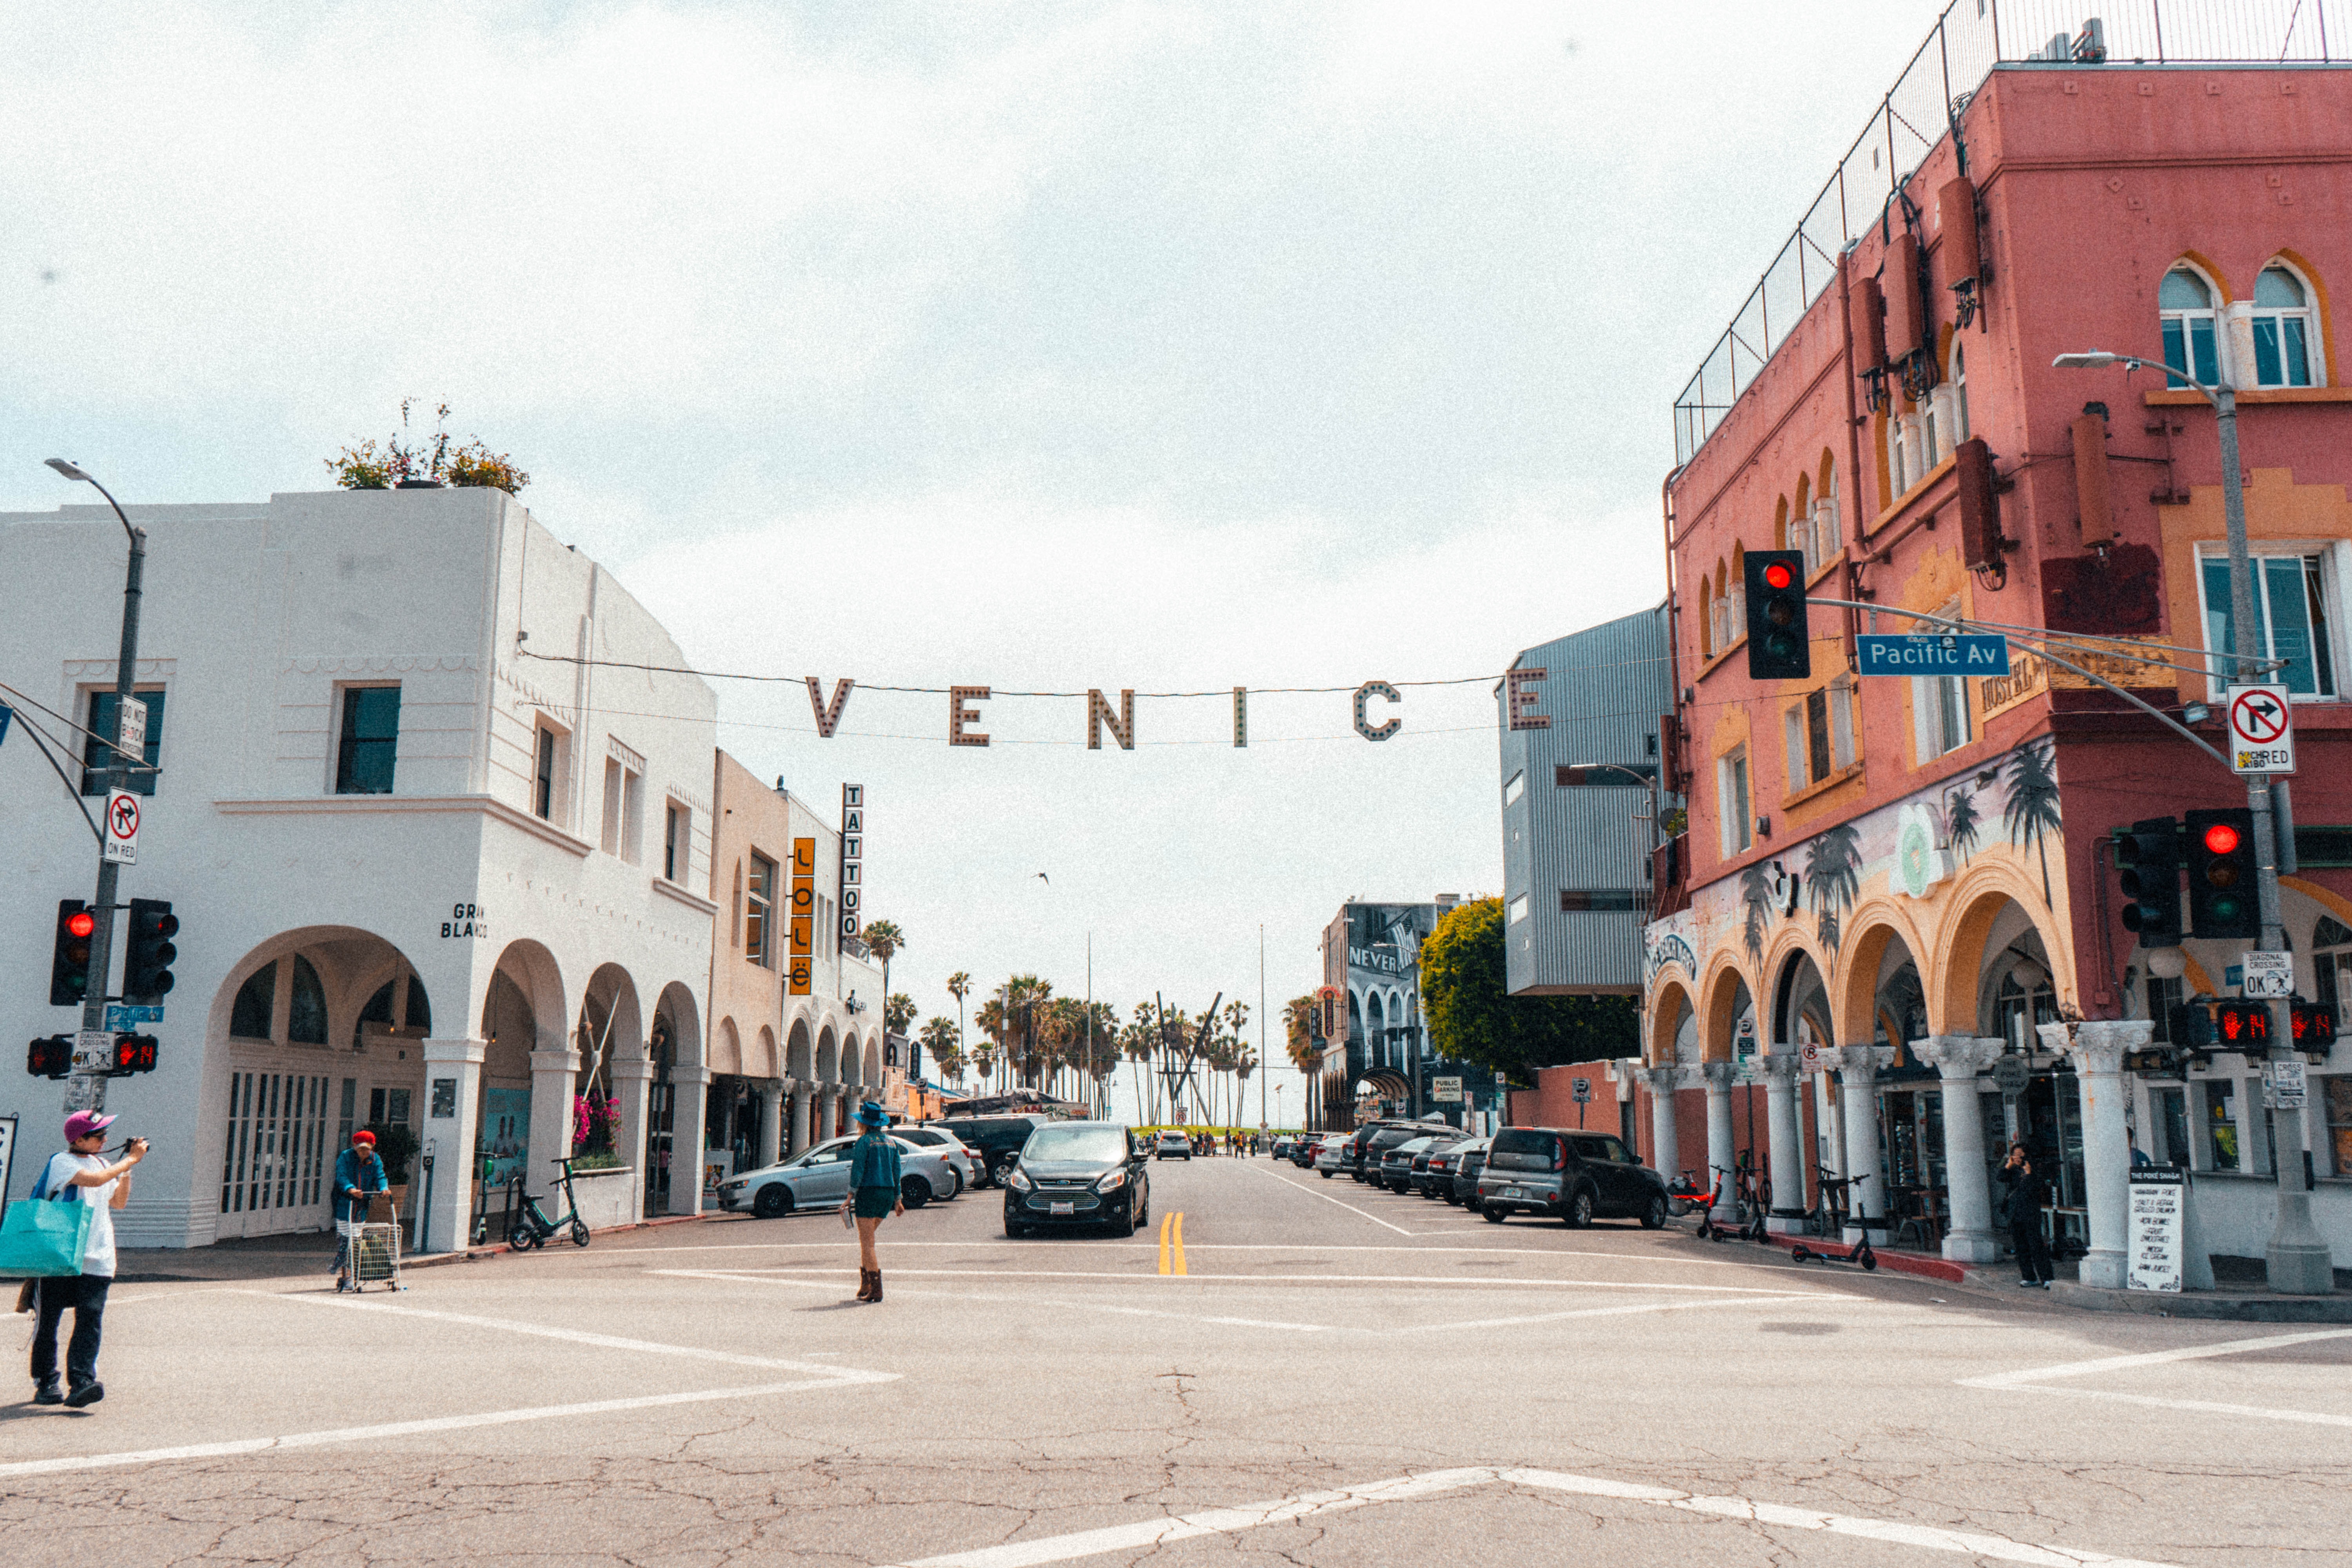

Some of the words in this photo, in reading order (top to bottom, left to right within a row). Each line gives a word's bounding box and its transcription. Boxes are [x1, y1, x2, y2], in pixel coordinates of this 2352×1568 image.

[1871, 643, 1958, 664] Pacific
[1967, 644, 1996, 664] Av
[1982, 658, 2032, 713] HOSTEL
[123, 704, 132, 719] DO
[134, 708, 145, 724] NOT
[805, 668, 1550, 750] VENICE
[2263, 750, 2288, 764] RED
[107, 842, 118, 854] ON
[121, 845, 134, 858] RED
[844, 787, 860, 933] TATTOO
[1349, 946, 1397, 972] NEVER
[2249, 961, 2286, 969] CROSSING
[2247, 976, 2266, 993] OK
[112, 1007, 143, 1018] Pacific
[75, 1051, 90, 1065] OK
